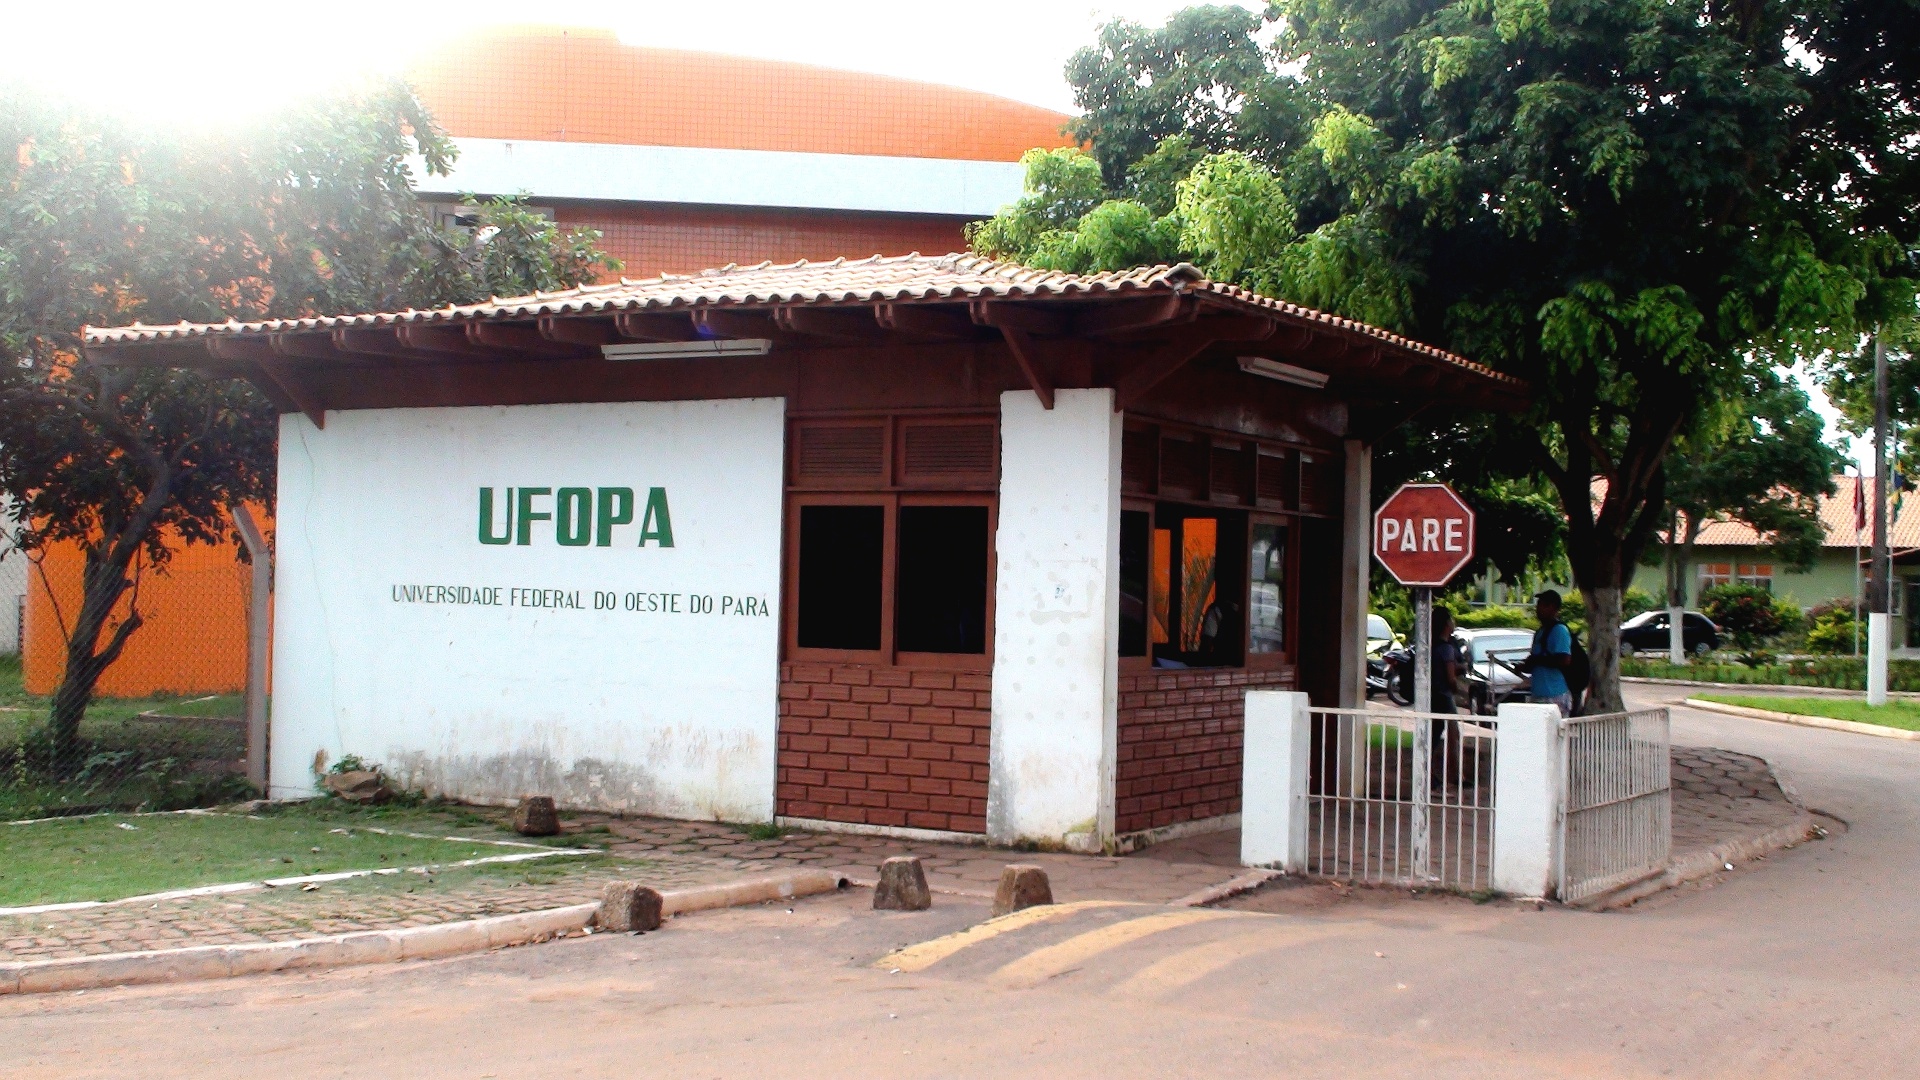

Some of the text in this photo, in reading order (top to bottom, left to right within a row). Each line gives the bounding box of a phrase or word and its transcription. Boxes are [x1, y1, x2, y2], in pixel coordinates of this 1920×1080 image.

[478, 486, 675, 548] UFOPA
[1381, 518, 1463, 552] PARE
[392, 584, 503, 606] UNIVERSIDADE
[511, 588, 586, 609] FEDERAL
[594, 590, 616, 610] DO
[625, 592, 682, 613] OESTE
[690, 594, 713, 614] DO
